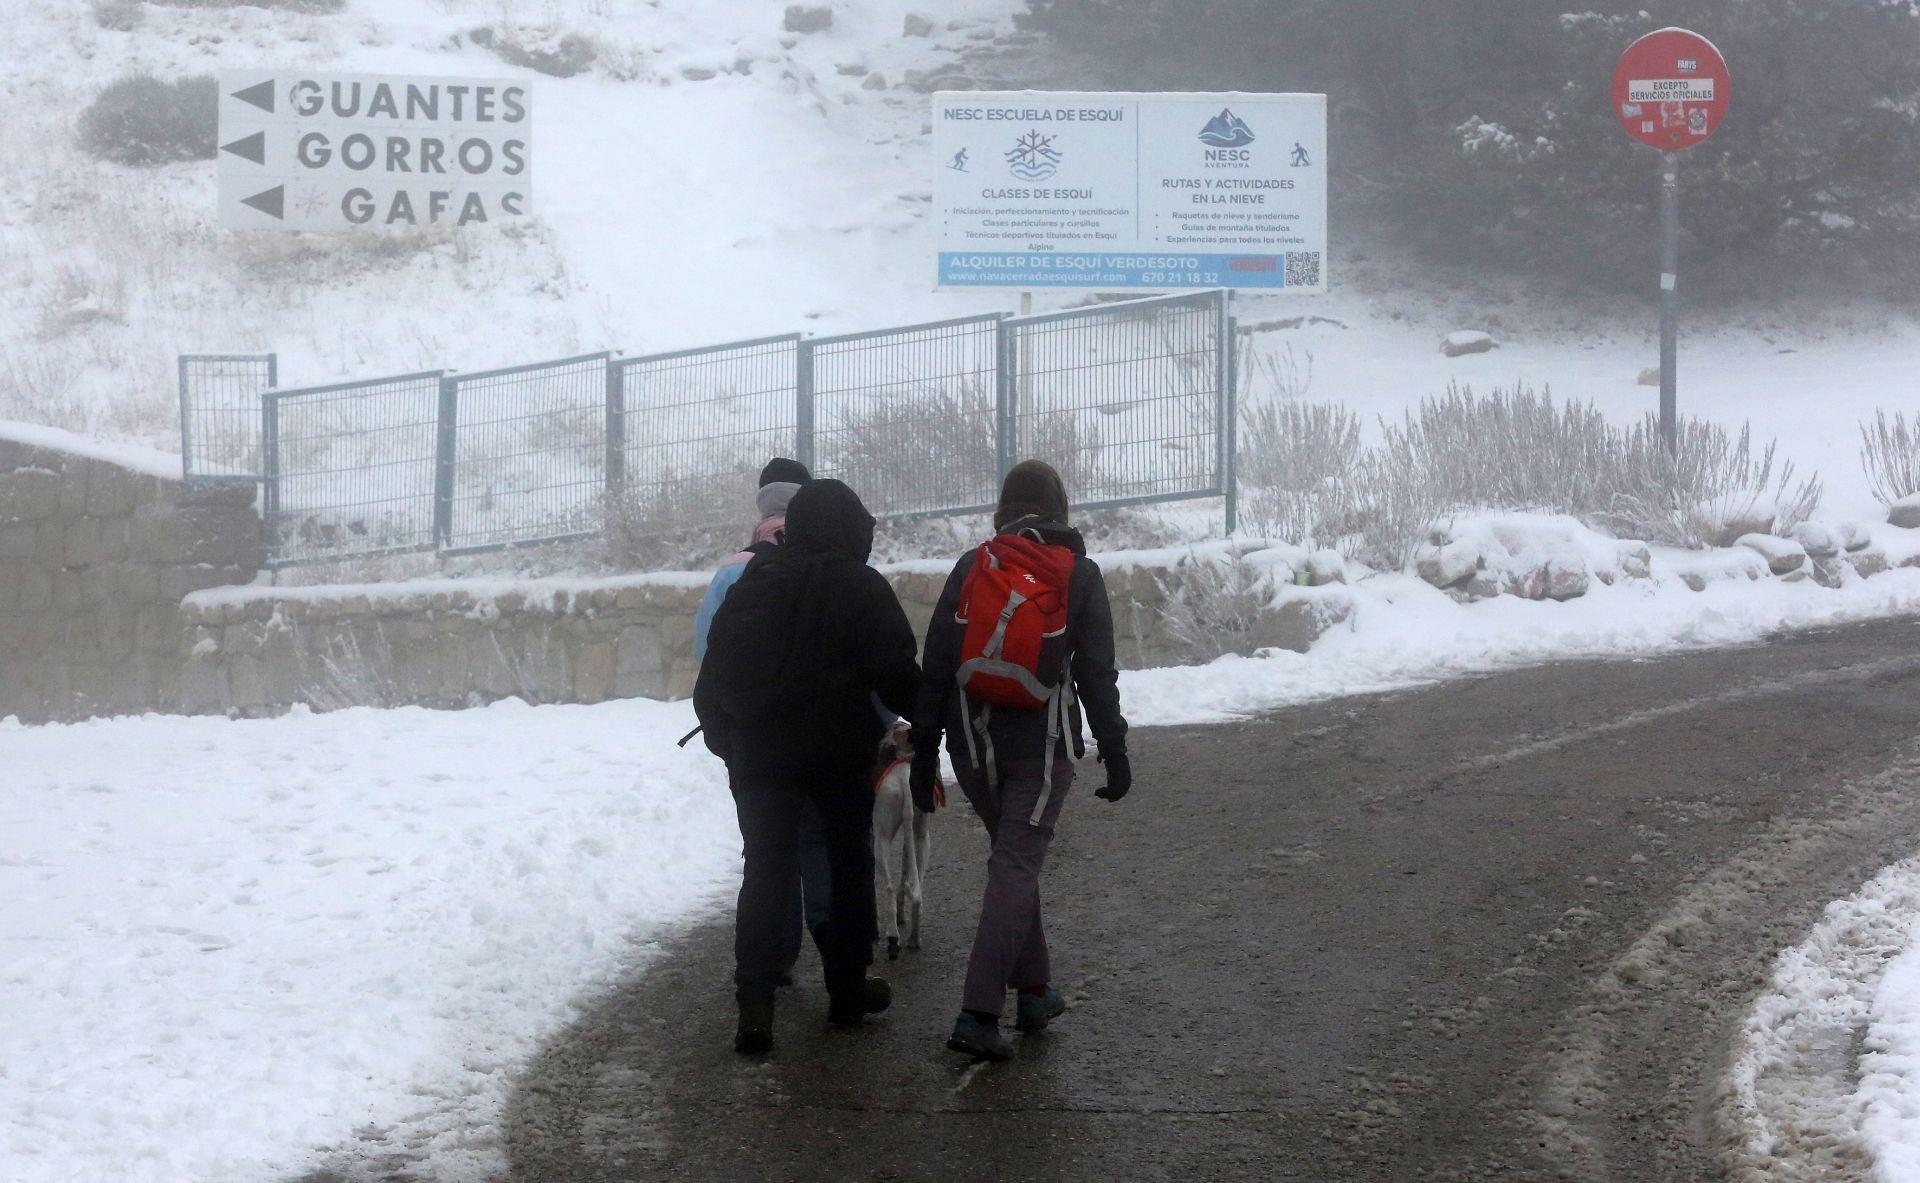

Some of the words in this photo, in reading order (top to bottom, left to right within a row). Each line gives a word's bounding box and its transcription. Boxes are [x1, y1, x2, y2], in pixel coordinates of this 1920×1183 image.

[1653, 81, 1689, 90] EXCEPTO
[1631, 92, 1670, 100] SERVICIOS
[1673, 90, 1712, 99] OFICIALES
[297, 80, 525, 123] GUANTES
[944, 108, 983, 120] NESC
[987, 109, 1051, 121] ESCUELA
[1056, 110, 1076, 121] DE
[1079, 107, 1124, 121] ESQUÍ
[297, 132, 525, 175] GORROS
[1205, 150, 1250, 161] NESC
[1162, 178, 1201, 189] RUTAS
[1205, 179, 1212, 189] Y
[1216, 179, 1295, 190] ACTIVIDADES
[982, 189, 1030, 199] CLASES
[1034, 189, 1050, 199] DE
[1054, 187, 1093, 200] ESQUÍ
[1192, 194, 1208, 204] EN
[1212, 194, 1226, 204] LA
[1230, 194, 1265, 204] NIEVE
[341, 187, 524, 226] GAFAS
[995, 208, 1070, 217] perfeccionamiento
[1078, 208, 1130, 216] tecnificación
[1172, 212, 1210, 220] Raquetas
[1212, 212, 1220, 220] de
[1223, 212, 1244, 220] nieve
[1254, 212, 1300, 220] senderismo
[982, 219, 1009, 227] Clases
[1011, 220, 1058, 228] particulares
[1066, 220, 1100, 228] cursillos
[1218, 224, 1254, 232] montaña
[1256, 224, 1290, 232] titulados
[1002, 232, 1044, 240] deportivos
[1046, 232, 1081, 240] titulados
[1167, 236, 1217, 244] Experiencias
[1220, 236, 1237, 245] para
[1239, 236, 1262, 244] todos
[1263, 236, 1275, 244] los
[1277, 236, 1304, 244] niveles
[1028, 243, 1054, 252] Alpino
[951, 256, 1026, 268] ALQUILER
[1030, 256, 1050, 268] DE
[1105, 257, 1198, 269] VERDESOTO
[947, 271, 1127, 282] www.navacerradaesquisurf.com
[1142, 272, 1165, 282] 670
[1168, 272, 1182, 282] 21
[1187, 272, 1200, 282] 18
[1204, 272, 1218, 283] 32
